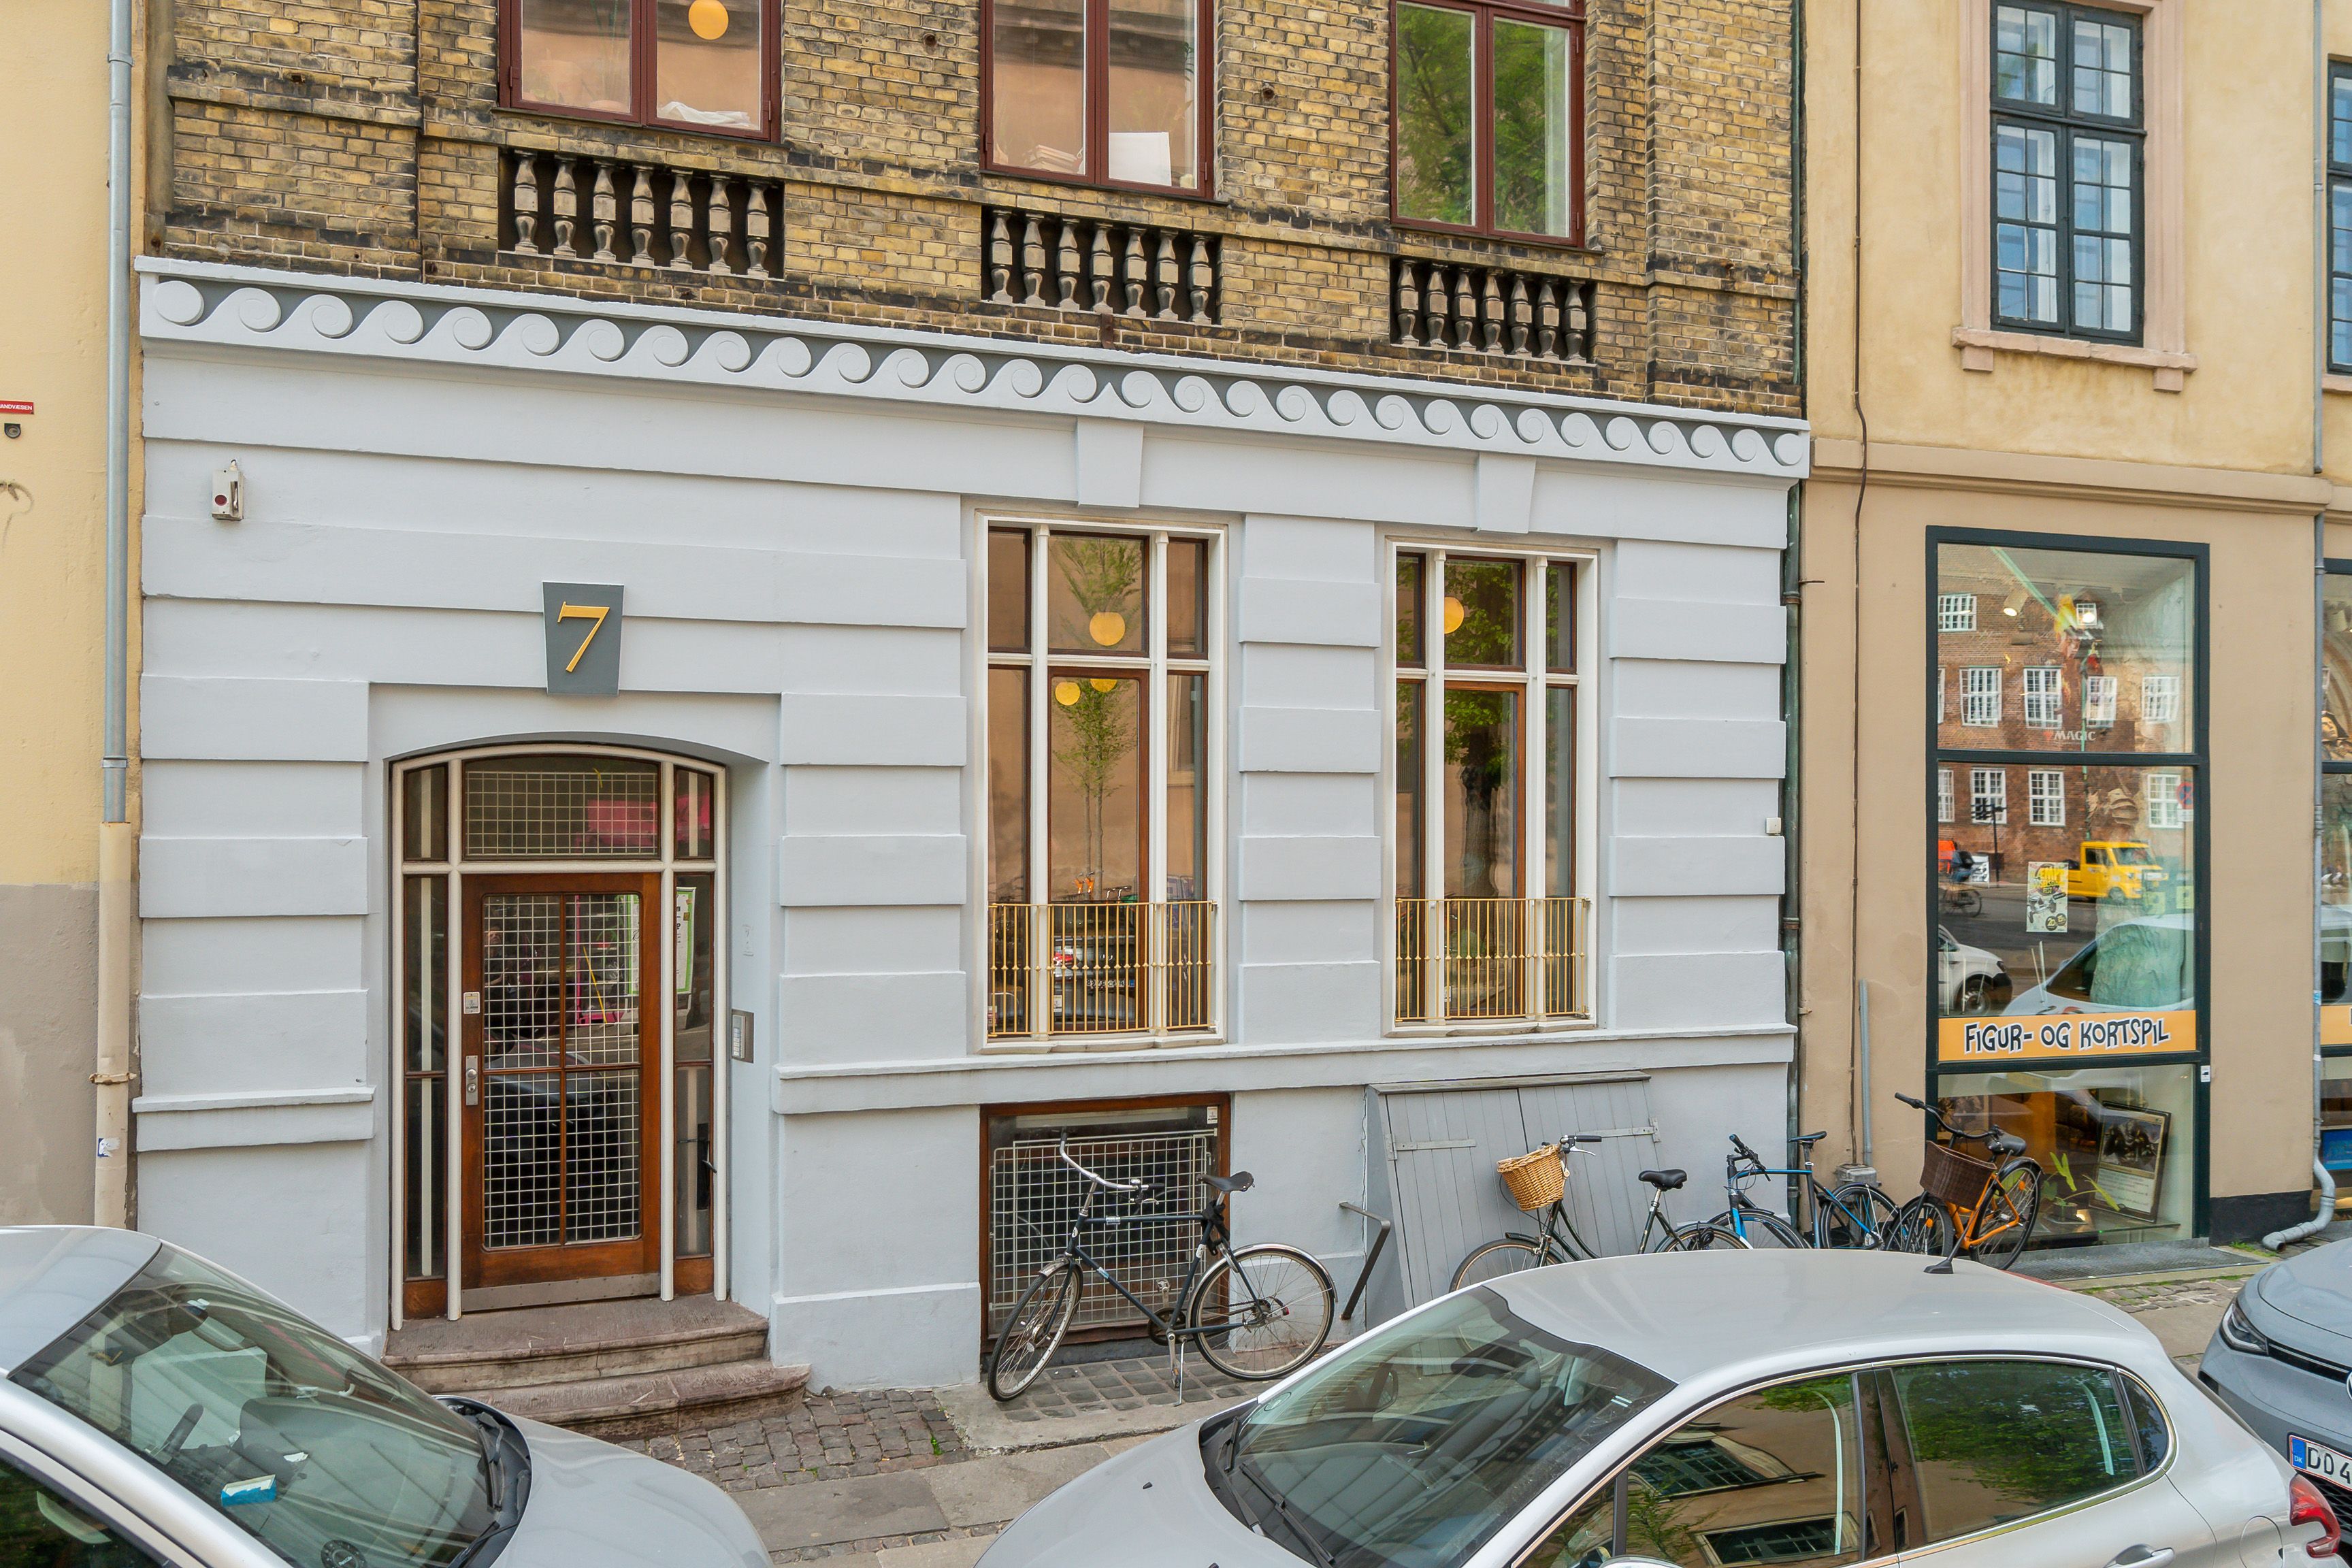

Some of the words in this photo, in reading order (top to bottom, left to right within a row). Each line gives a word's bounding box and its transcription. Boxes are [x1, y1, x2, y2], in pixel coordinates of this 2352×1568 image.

[557, 601, 610, 672] 7
[2054, 730, 2097, 741] MAGIC
[1965, 1022, 2034, 1054] FIGUR-
[2040, 1022, 2073, 1049] OG
[2079, 1017, 2170, 1051] KORTSPIL
[2294, 1455, 2303, 1464] DK
